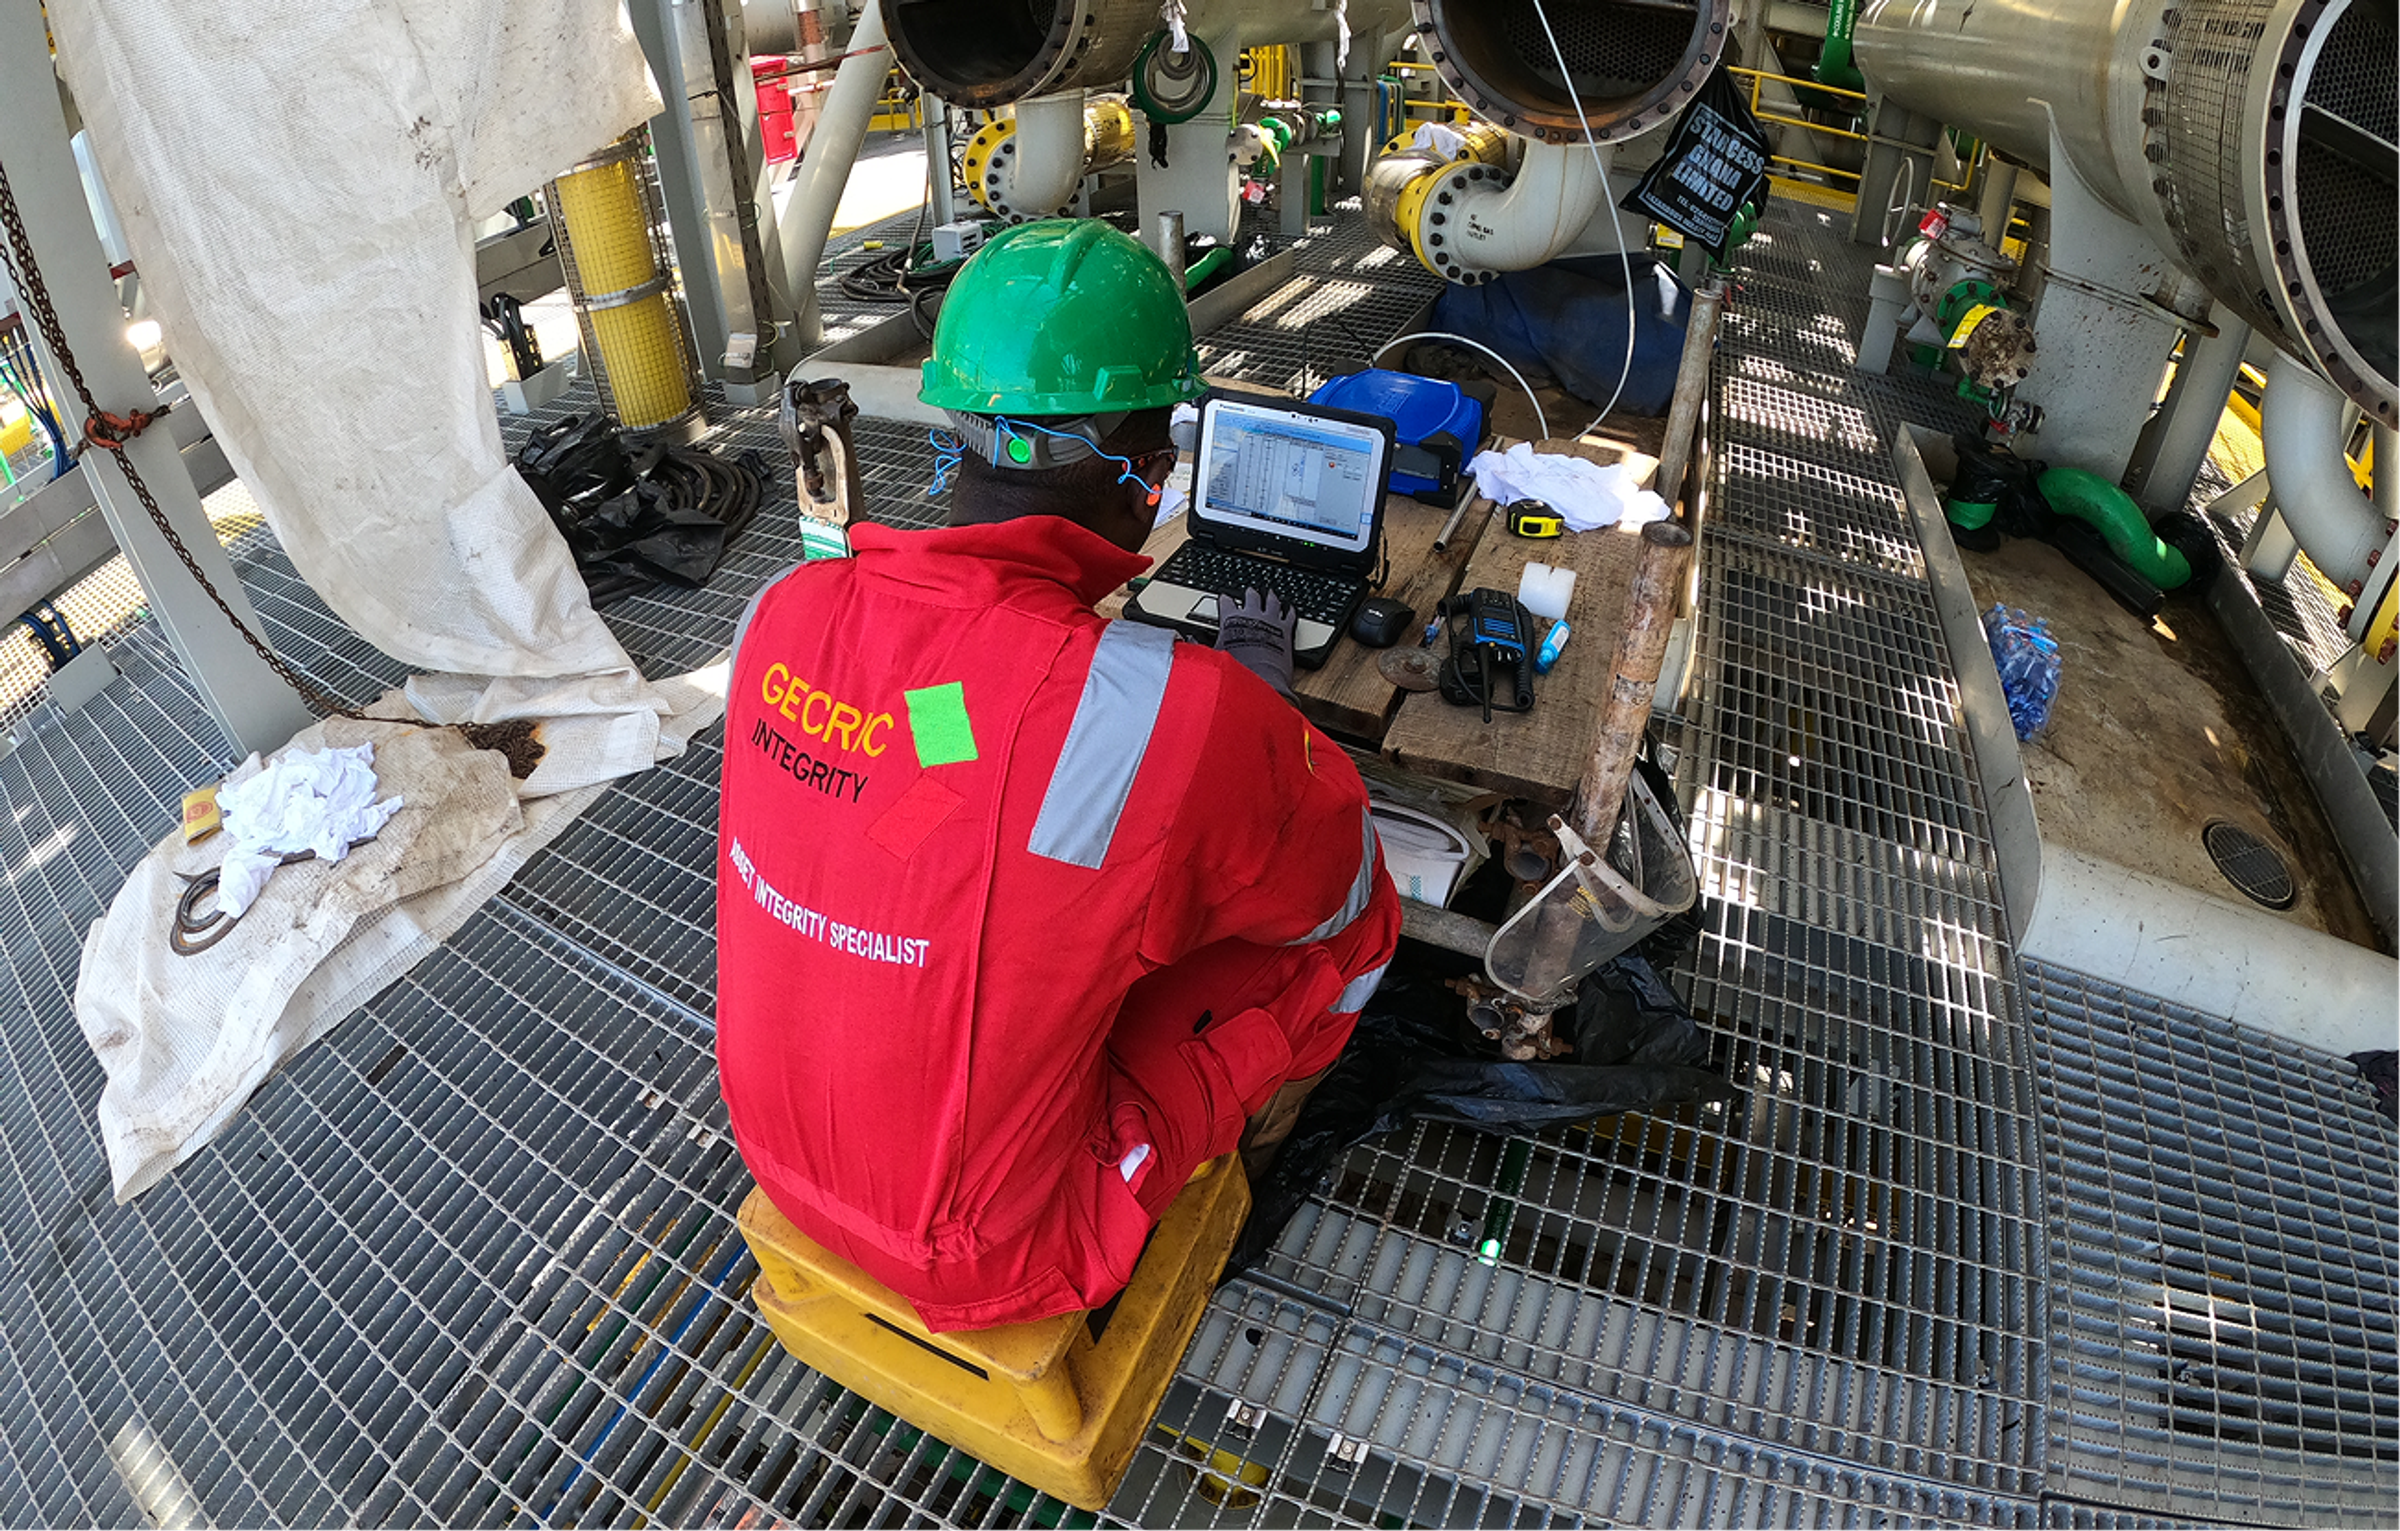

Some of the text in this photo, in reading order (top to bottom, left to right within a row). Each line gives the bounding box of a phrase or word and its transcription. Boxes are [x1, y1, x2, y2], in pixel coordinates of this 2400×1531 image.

[1672, 162, 1734, 212] LIMITED
[1689, 144, 1742, 190] GHANA
[762, 663, 894, 757] GECRIC
[752, 718, 868, 803] INTEGRITY
[755, 874, 827, 942] INTEGRITY
[830, 921, 930, 968] SPECIALIST
